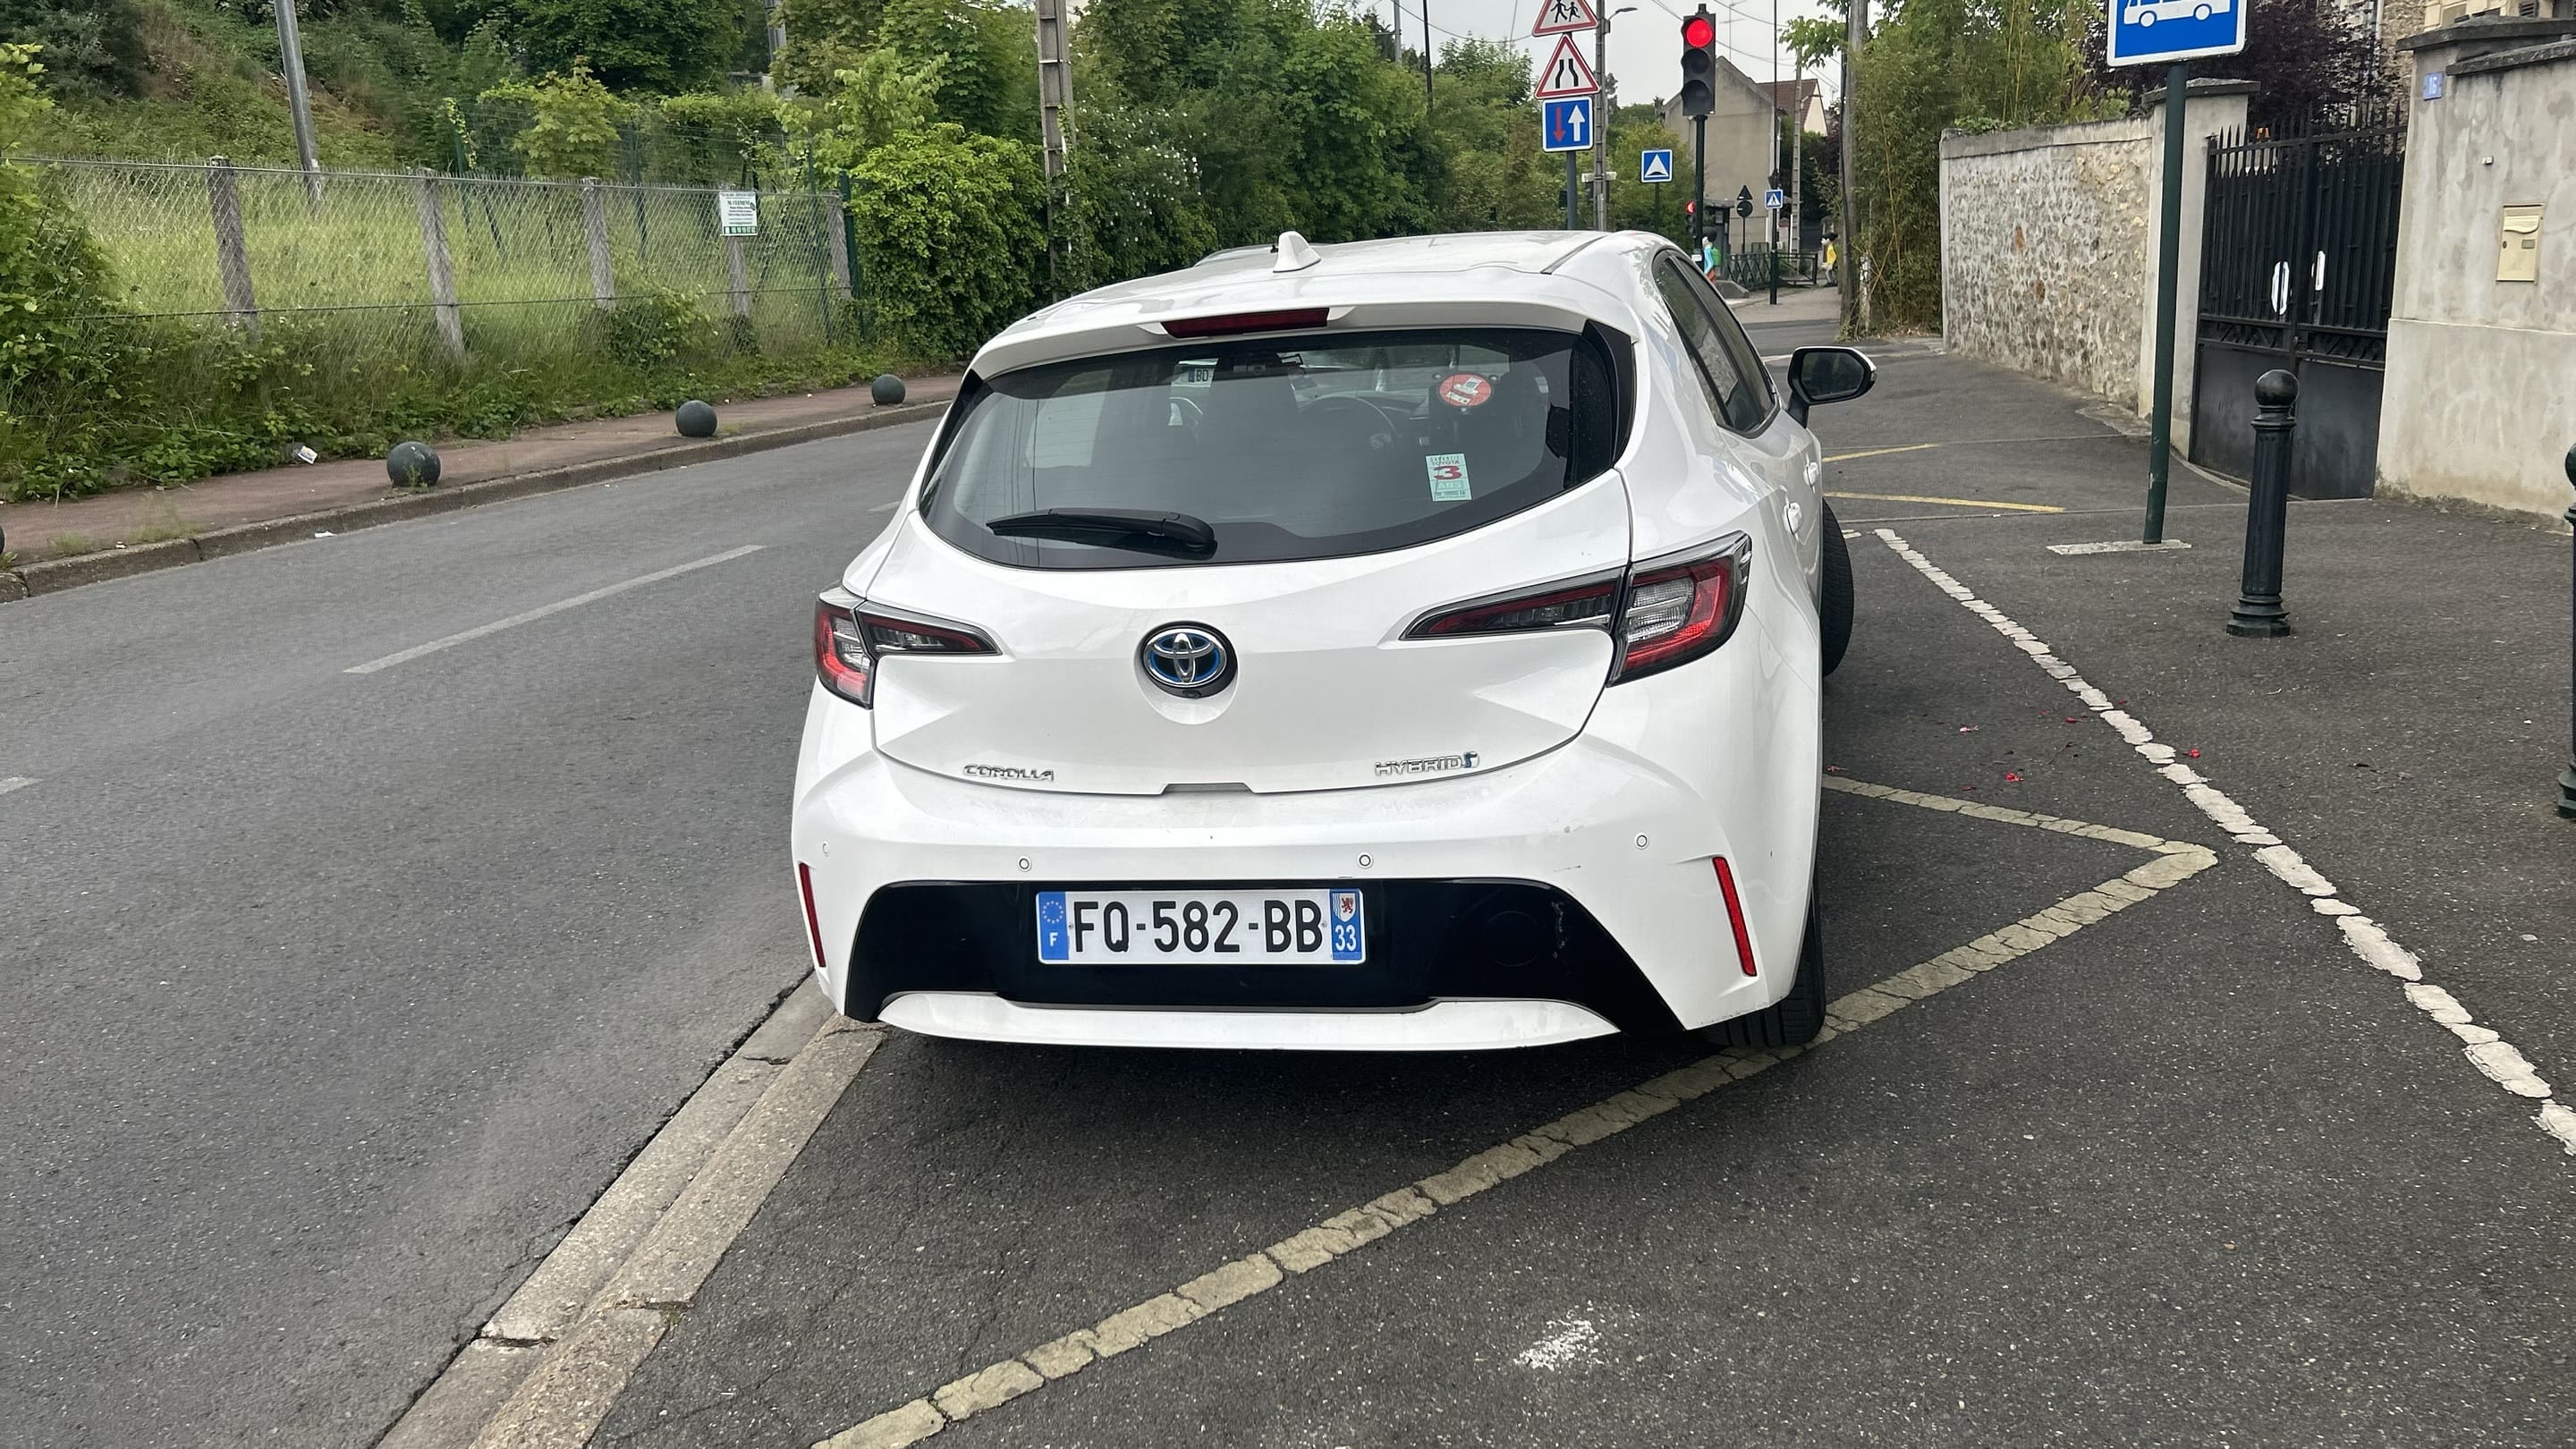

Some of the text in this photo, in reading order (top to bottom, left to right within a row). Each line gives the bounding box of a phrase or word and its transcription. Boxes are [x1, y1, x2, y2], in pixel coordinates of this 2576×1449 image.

[1433, 465, 1463, 480] 3
[962, 764, 1055, 783] COROLLA
[1374, 755, 1463, 776] HYBRID
[1073, 899, 1324, 953] FQ-582-BB
[1048, 931, 1059, 947] F
[1334, 924, 1358, 952] 33
